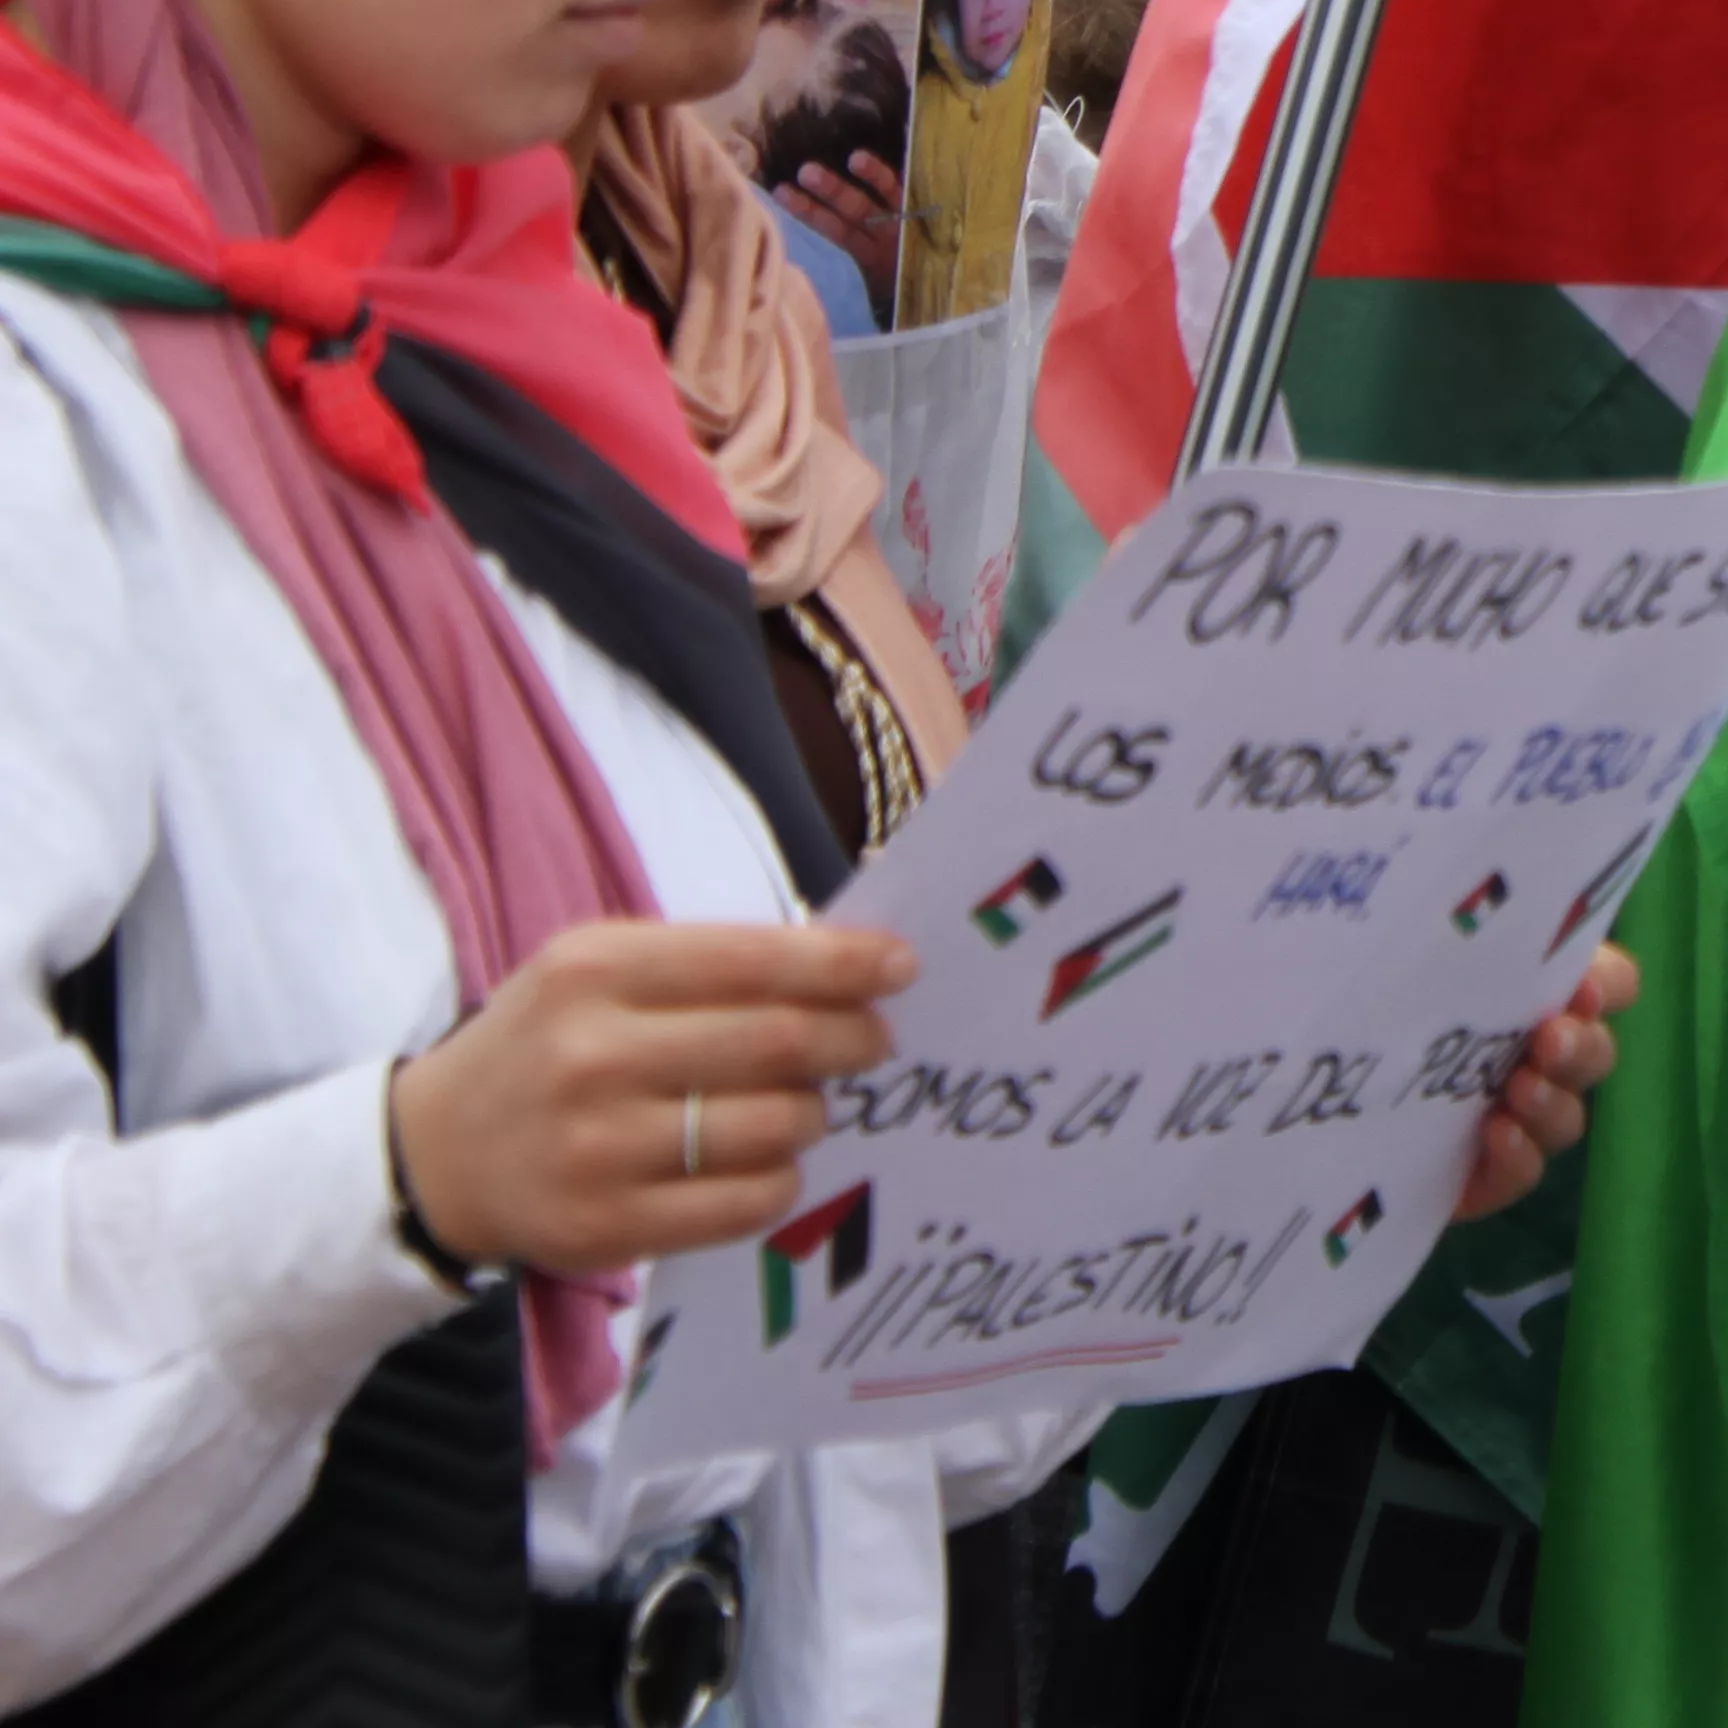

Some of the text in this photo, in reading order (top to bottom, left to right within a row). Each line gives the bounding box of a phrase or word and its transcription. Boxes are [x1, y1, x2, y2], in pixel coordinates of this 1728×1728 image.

[1130, 498, 1341, 646] POR
[1343, 532, 1572, 652] MUCHO
[1576, 546, 1706, 634] QUE
[1029, 704, 1172, 808] LOS
[826, 1056, 1057, 1140] SOMOS
[1047, 1068, 1142, 1149] LA
[1264, 1046, 1384, 1138] DEL
